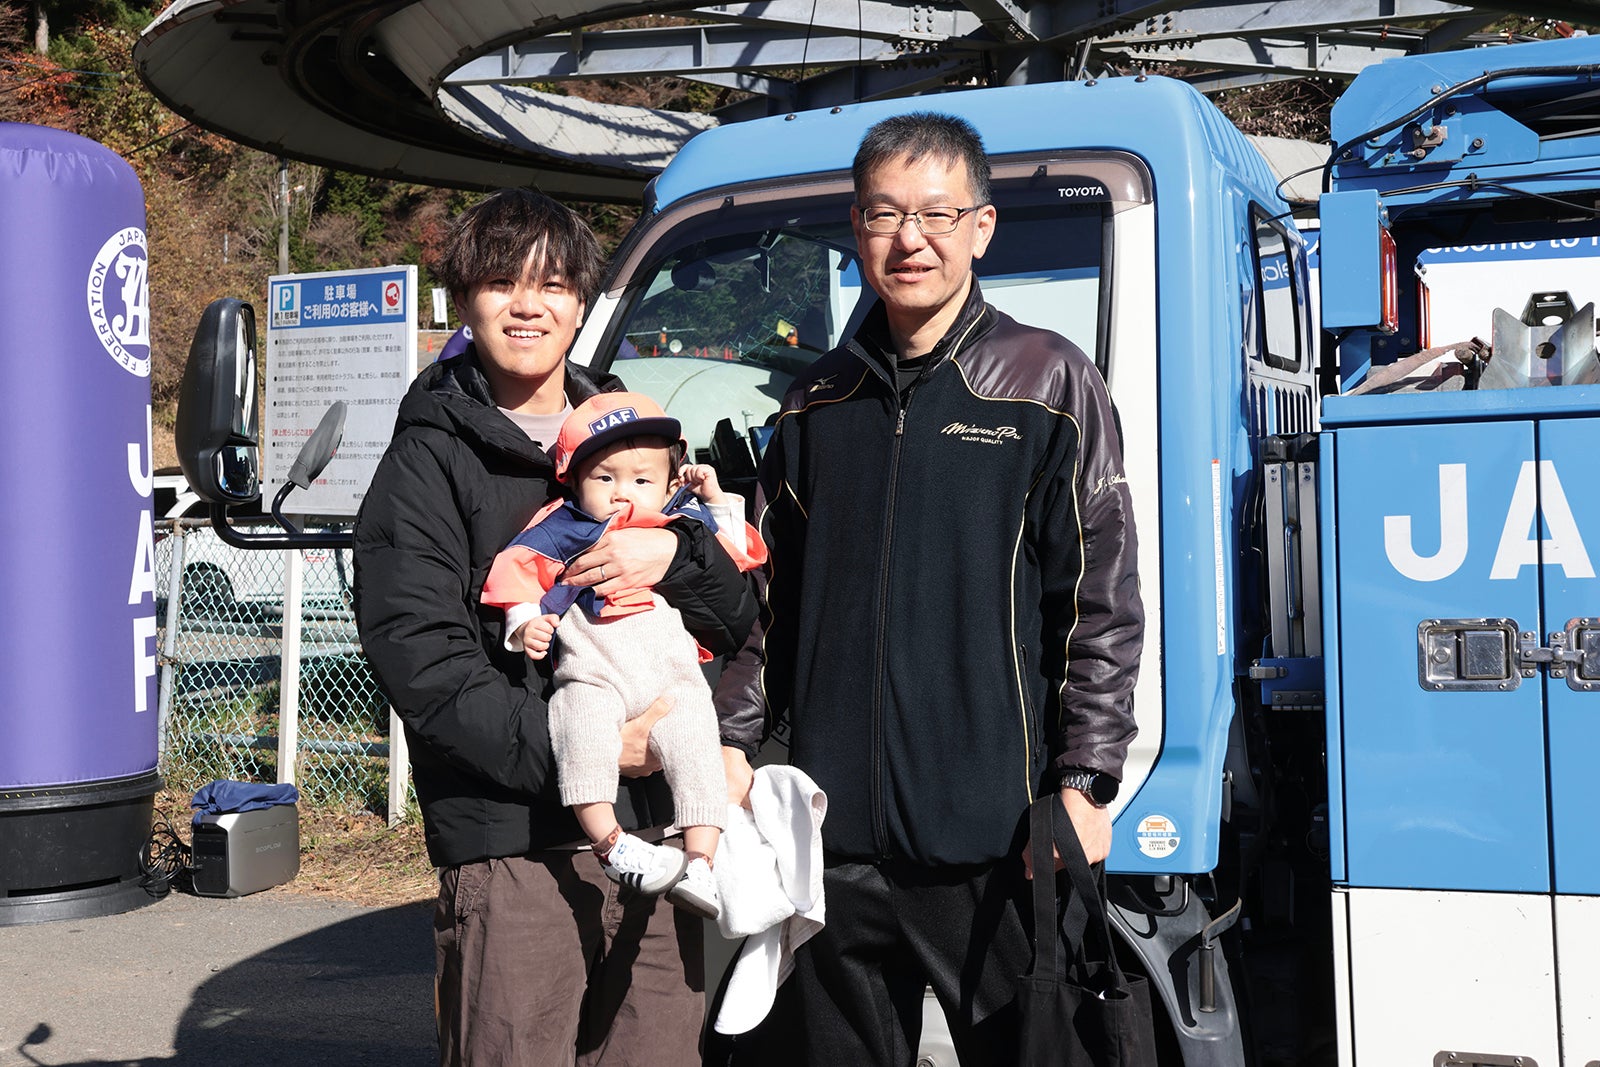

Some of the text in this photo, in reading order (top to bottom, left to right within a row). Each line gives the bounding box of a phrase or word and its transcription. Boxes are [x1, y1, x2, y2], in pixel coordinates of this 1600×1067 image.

[1058, 186, 1104, 198] TOYOTA
[281, 288, 292, 309] P
[324, 284, 357, 301] 駐車場
[91, 262, 137, 372] FEDERATION
[303, 302, 379, 320] ご利用のお客様へ
[595, 409, 632, 432] JAF
[980, 437, 1003, 445] QUALITY
[1383, 459, 1597, 582] JA
[127, 403, 157, 713] JAF
